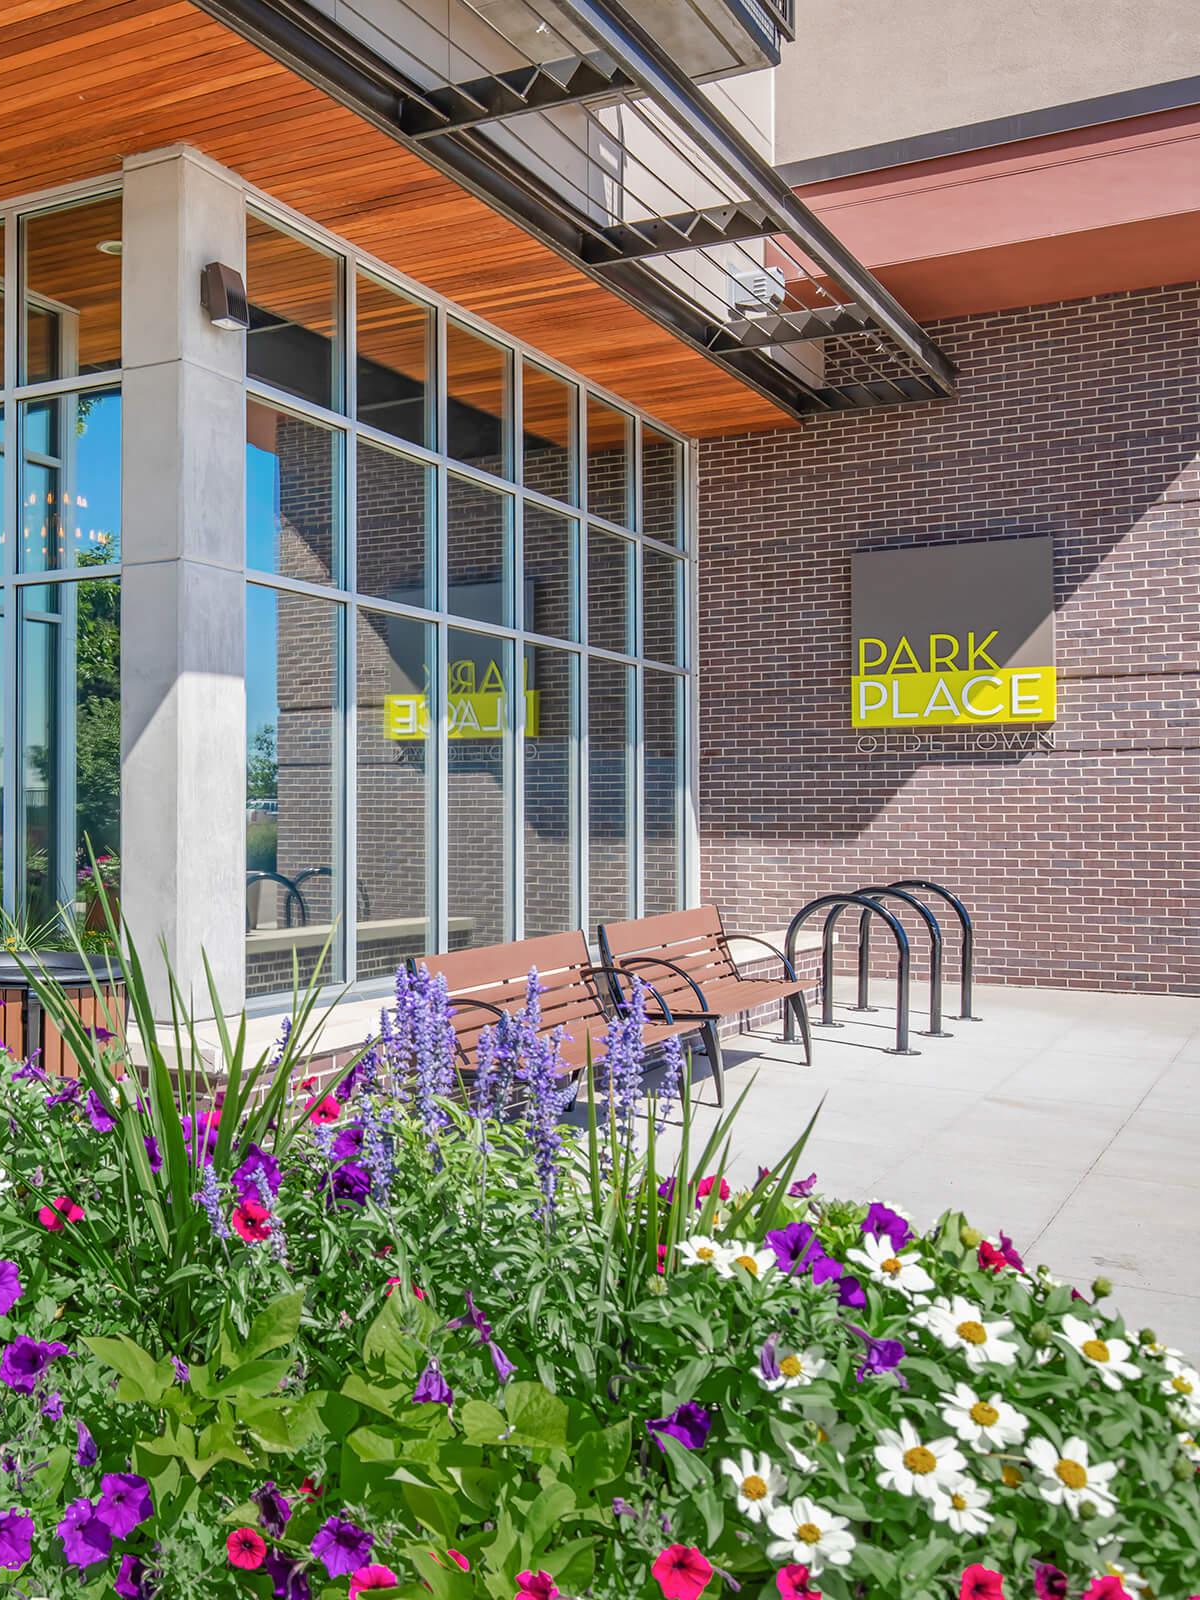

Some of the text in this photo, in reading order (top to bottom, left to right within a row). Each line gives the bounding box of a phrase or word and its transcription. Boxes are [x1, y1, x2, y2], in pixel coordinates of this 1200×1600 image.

[858, 630, 1002, 677] PARK
[859, 673, 1044, 720] PLACE
[856, 730, 1056, 754] OLDE TOWN
